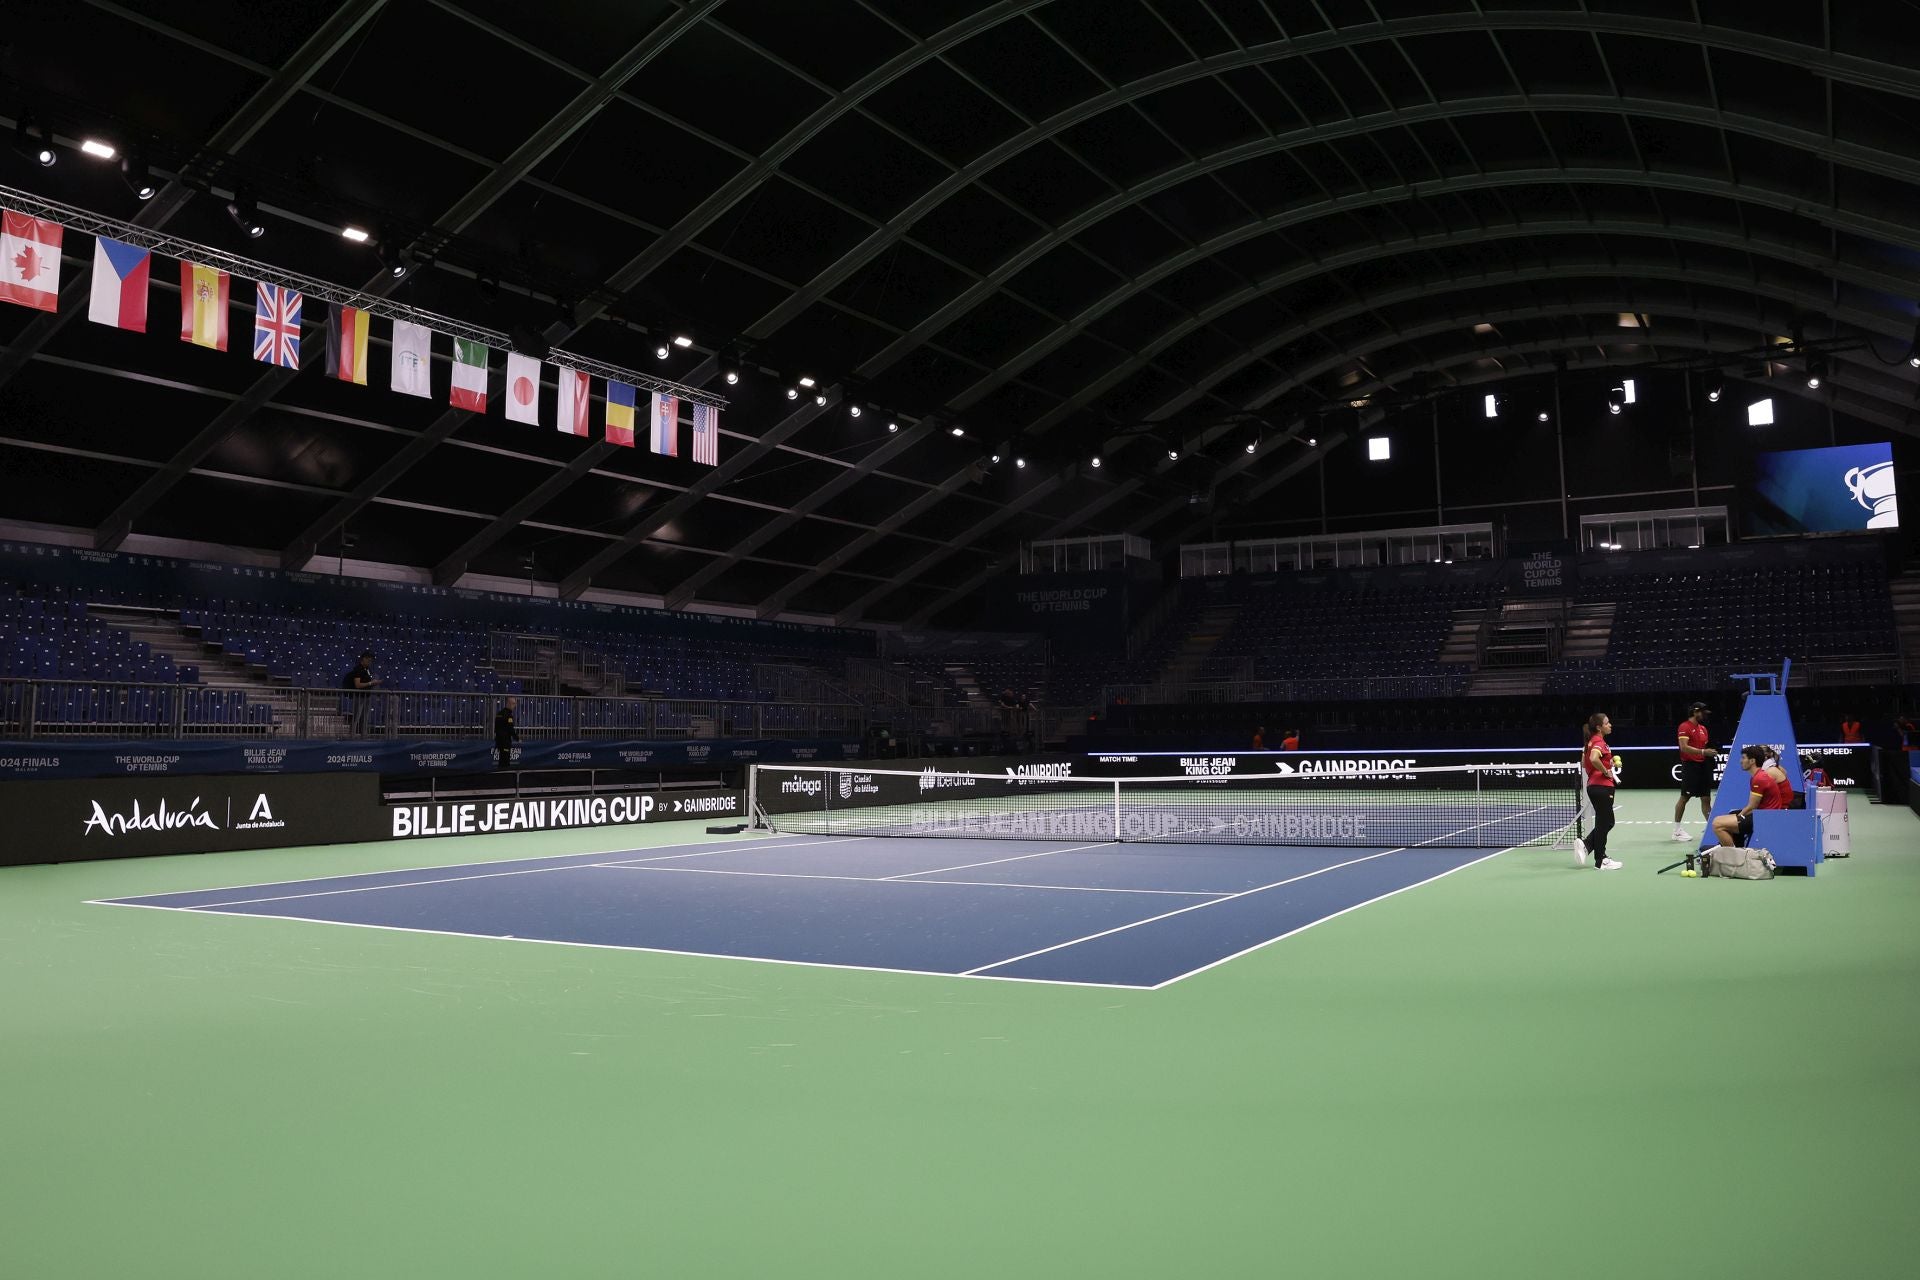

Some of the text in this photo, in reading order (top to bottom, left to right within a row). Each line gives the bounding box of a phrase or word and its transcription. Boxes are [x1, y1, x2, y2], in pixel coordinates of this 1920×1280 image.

[1531, 551, 1552, 561] THE
[1523, 560, 1562, 570] WORLD
[1524, 569, 1561, 579] CUP OF
[1524, 577, 1562, 588] TENNIS
[1016, 587, 1108, 603] THE WORLD CUP
[1031, 599, 1090, 613] OF TENNIS
[243, 748, 288, 757] BILLIE JEAN
[572, 752, 592, 760] FINALS
[1823, 747, 1852, 755] SPEED:
[0, 757, 60, 767] 024 FINALS
[115, 754, 181, 764] THE WORLD CUP
[247, 755, 284, 764] KING CUP
[326, 754, 373, 764] 2024 FINALS
[409, 753, 457, 761] THE WORLD CUP
[1180, 757, 1236, 767] BILLIE JEAN
[126, 762, 168, 772] OF TENNIS
[1185, 766, 1232, 776] KING CUP
[1299, 759, 1417, 780] GAINBRIDGE
[853, 774, 872, 783] Ciudad
[1017, 762, 1072, 785] GAINBRIDGE
[782, 774, 822, 796] málaga
[1833, 777, 1855, 786] km/h
[82, 795, 220, 837] Andalucía
[392, 794, 737, 837] BILLIE JEAN KING CUP BY GAINBRIDGE
[259, 820, 285, 828] Andalucía
[910, 809, 979, 833] BILLIE
[982, 812, 1044, 834] JEAN
[1051, 811, 1113, 836] KING
[1125, 812, 1179, 836] CUP
[1235, 813, 1367, 838] GAINBRIDGE
